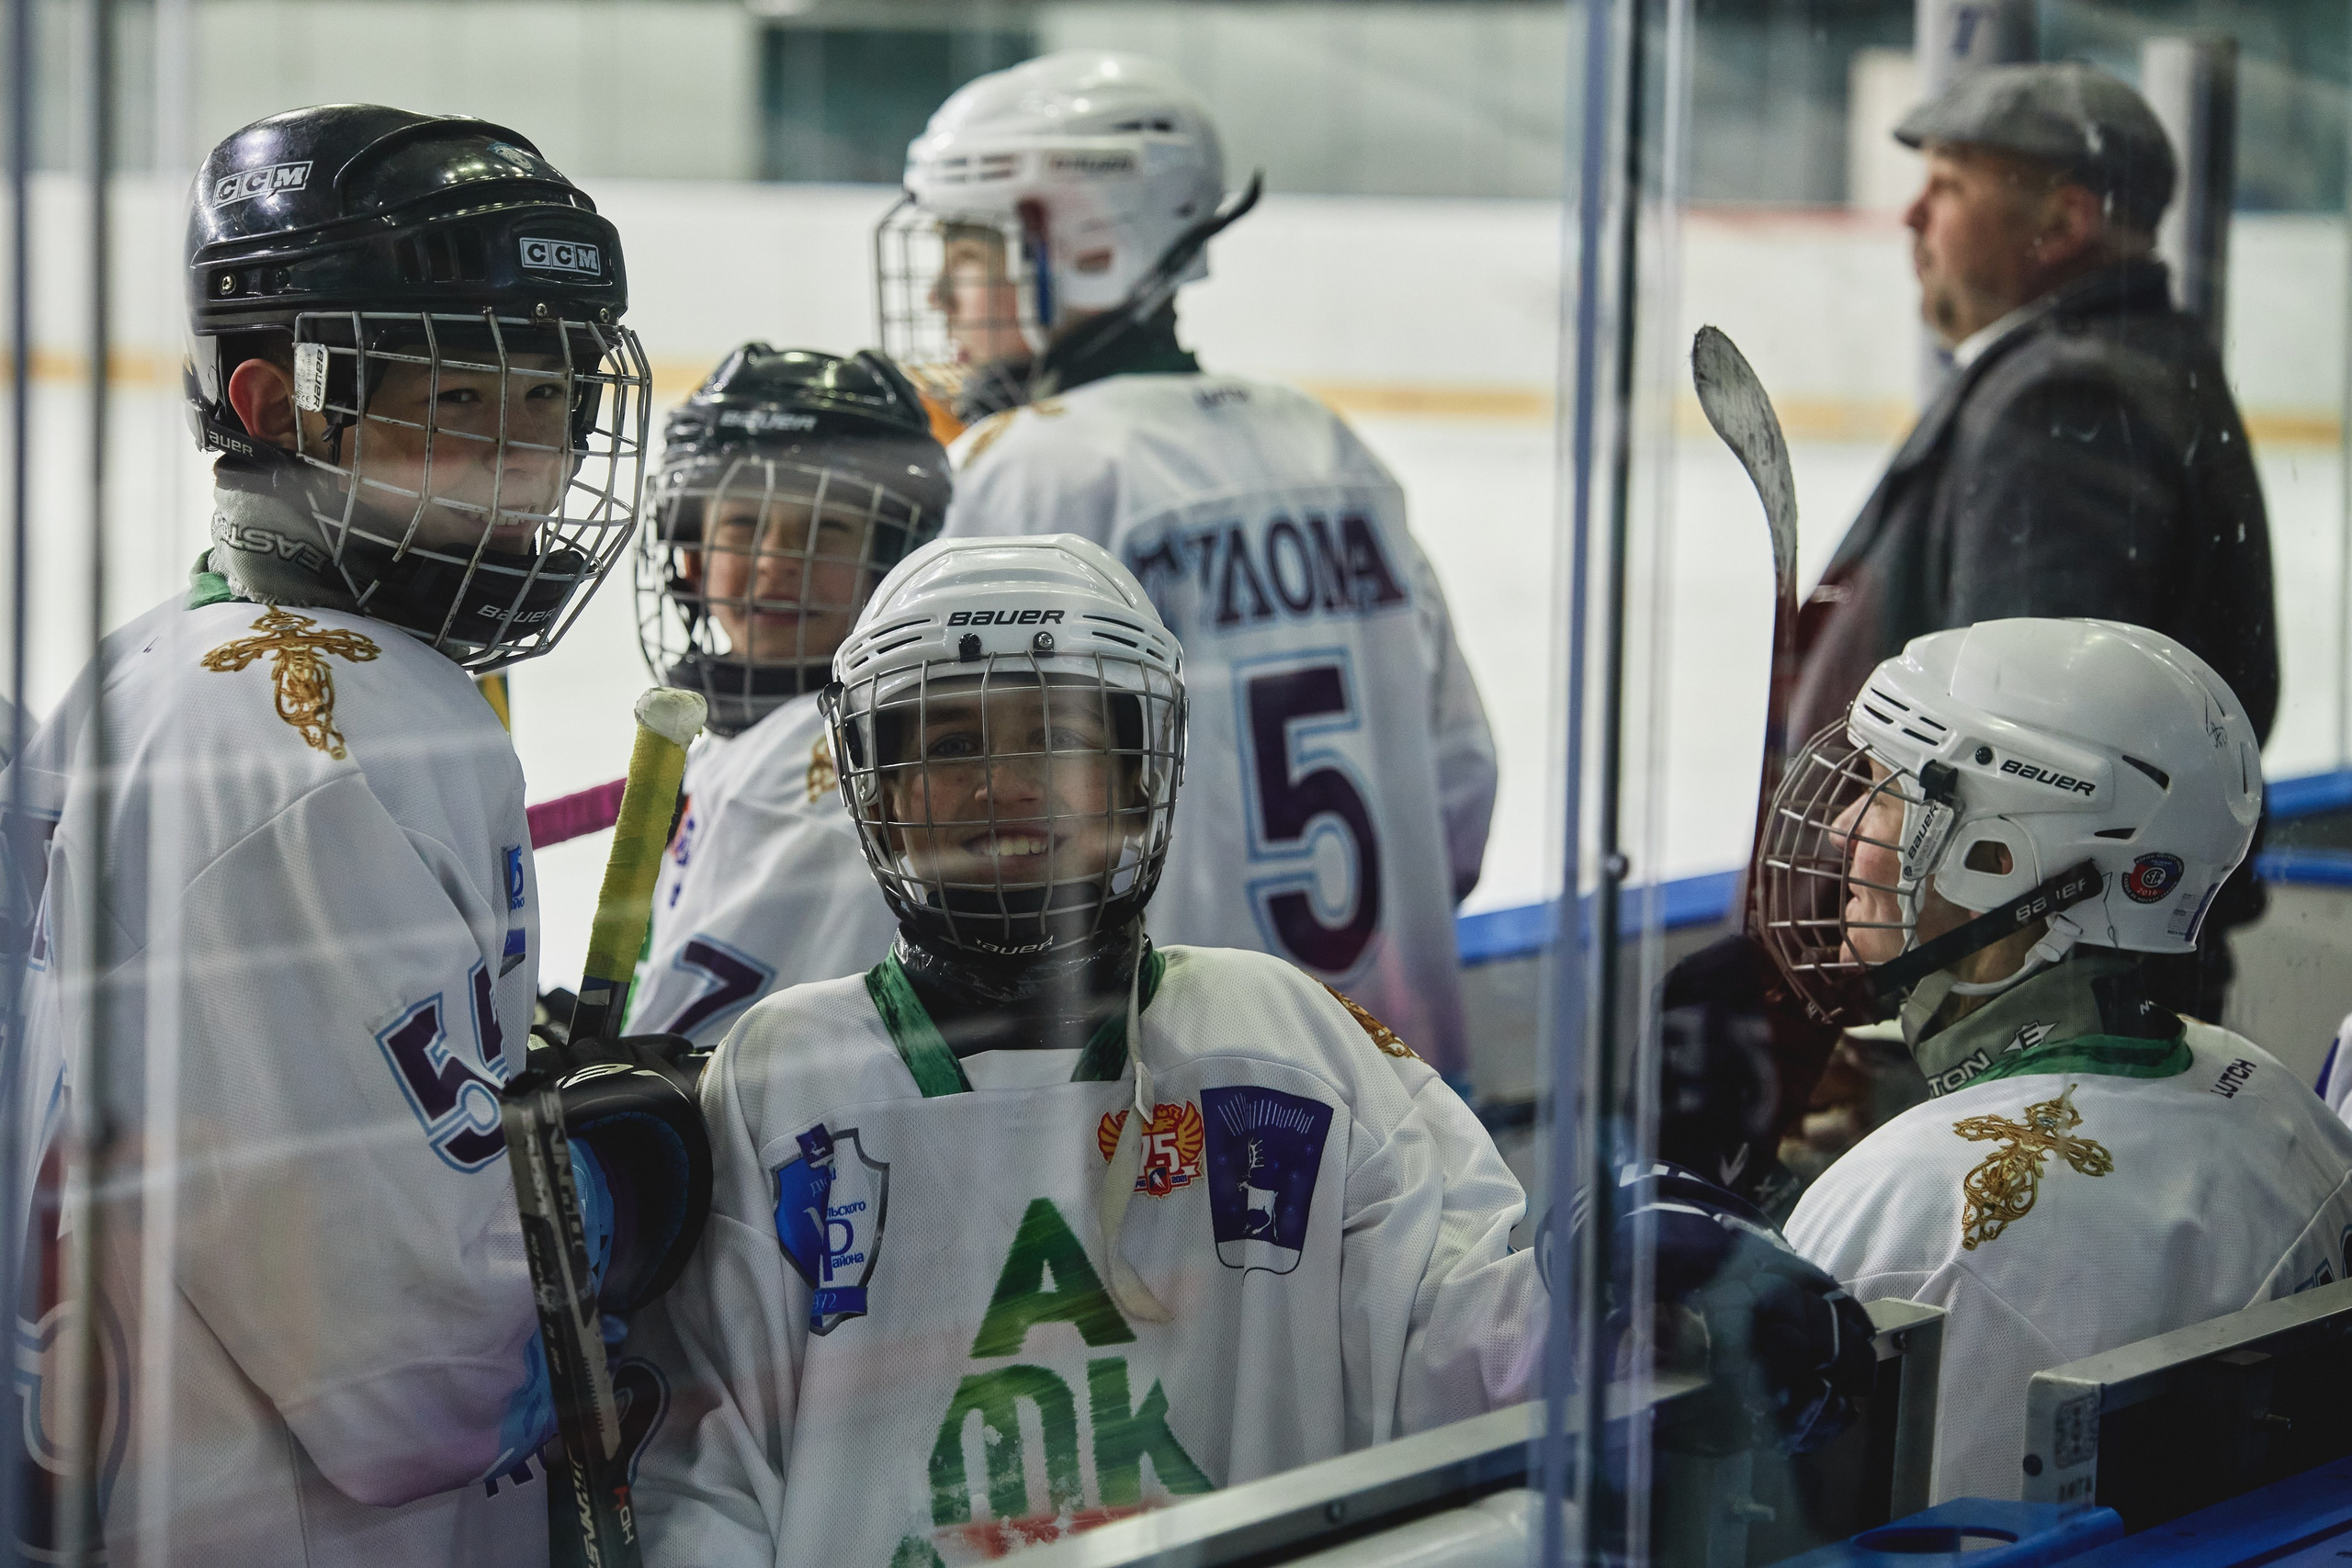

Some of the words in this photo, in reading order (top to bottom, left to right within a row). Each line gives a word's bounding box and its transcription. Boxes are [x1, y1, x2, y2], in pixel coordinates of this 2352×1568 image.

[217, 166, 307, 201] CCM
[526, 243, 597, 270] CCM
[314, 349, 323, 408] BAUER
[207, 428, 254, 457] AUER
[211, 516, 333, 574] EAST
[946, 610, 1066, 626] BAUER
[2000, 759, 2097, 796] BAUER
[1236, 647, 1382, 977] 5
[1907, 805, 1939, 860] BAUER
[2016, 878, 2086, 922] BAER
[2136, 886, 2158, 897] 2016
[975, 935, 1054, 955] AUER
[2210, 1058, 2257, 1100] LUTCH
[825, 1201, 866, 1218] льского
[812, 1292, 837, 1310] 972
